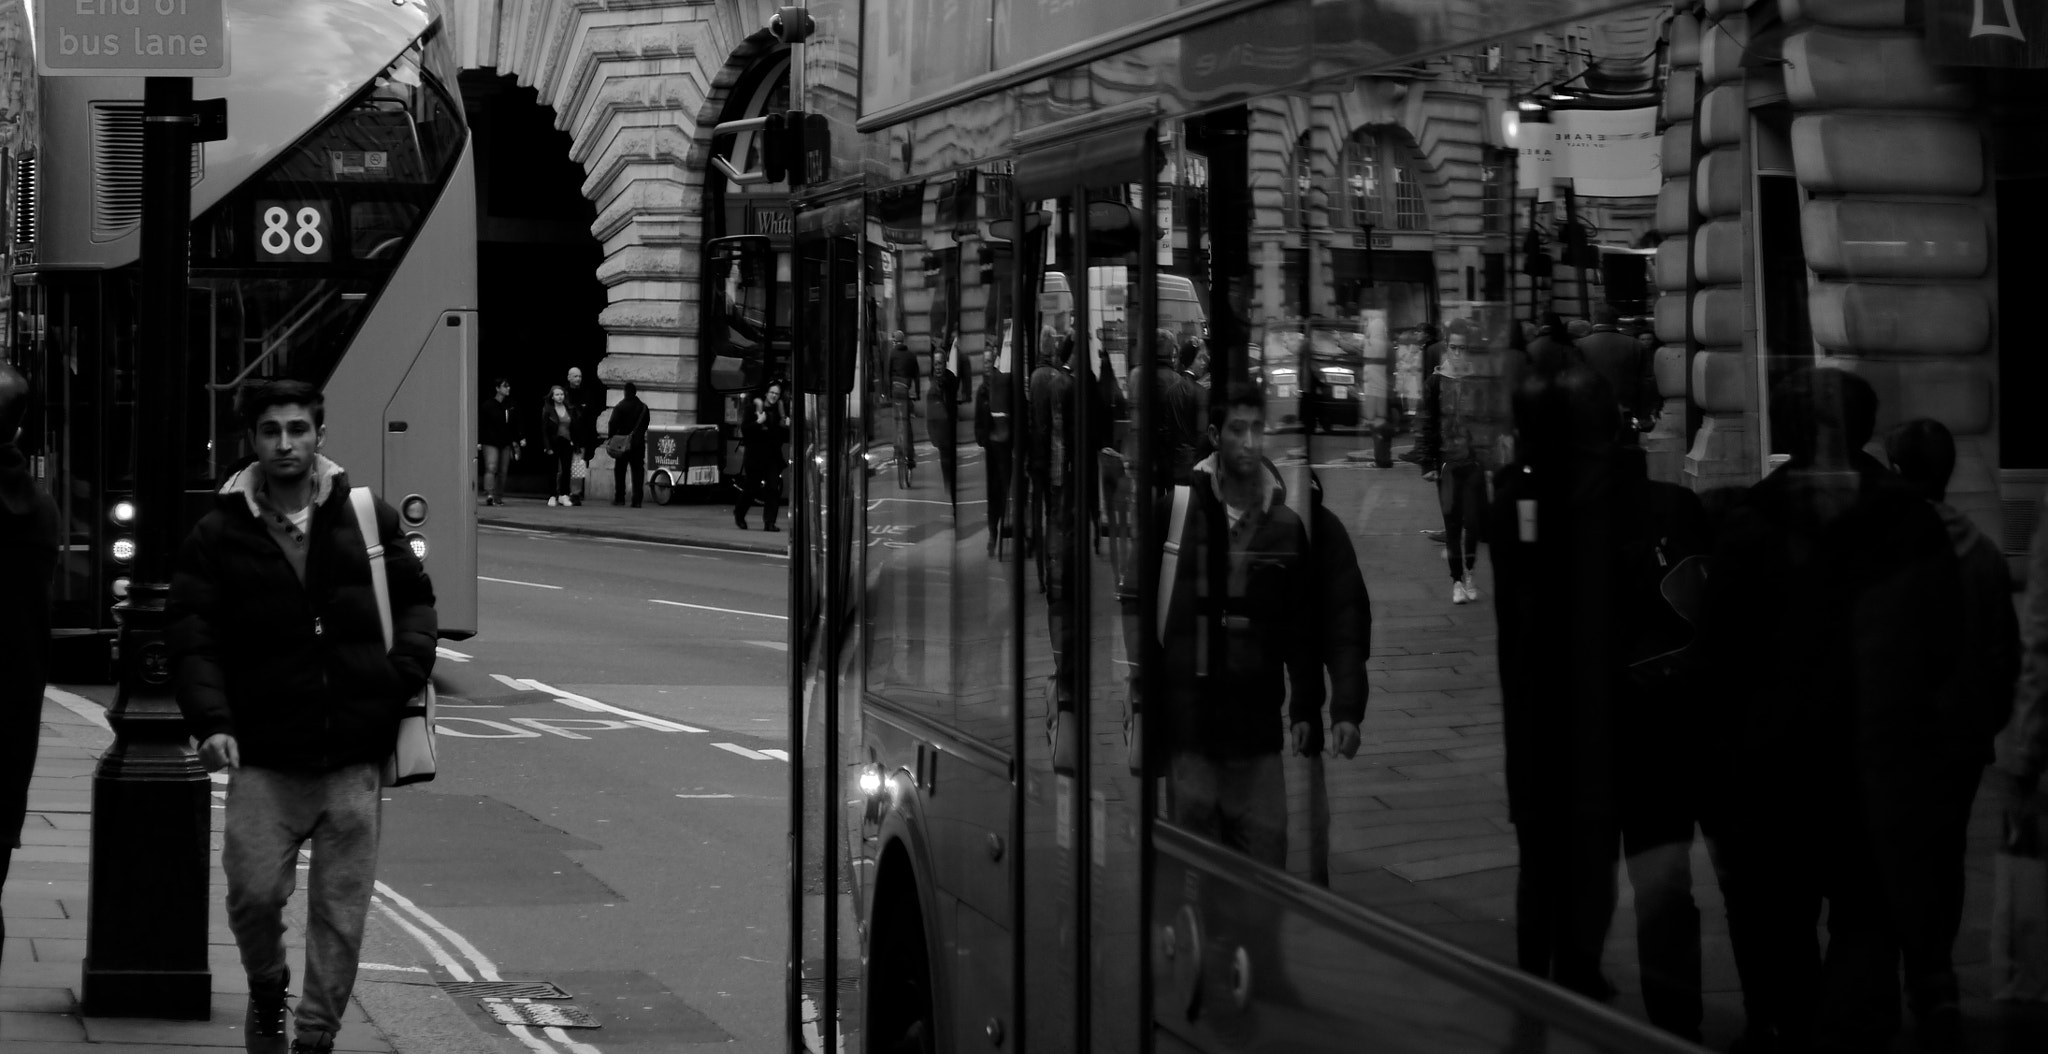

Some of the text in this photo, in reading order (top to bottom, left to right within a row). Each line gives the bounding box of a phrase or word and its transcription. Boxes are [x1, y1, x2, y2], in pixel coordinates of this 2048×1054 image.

[76, 0, 140, 16] End
[59, 27, 208, 56] bus lane
[260, 206, 324, 256] 88
[654, 455, 680, 466] Whittard
